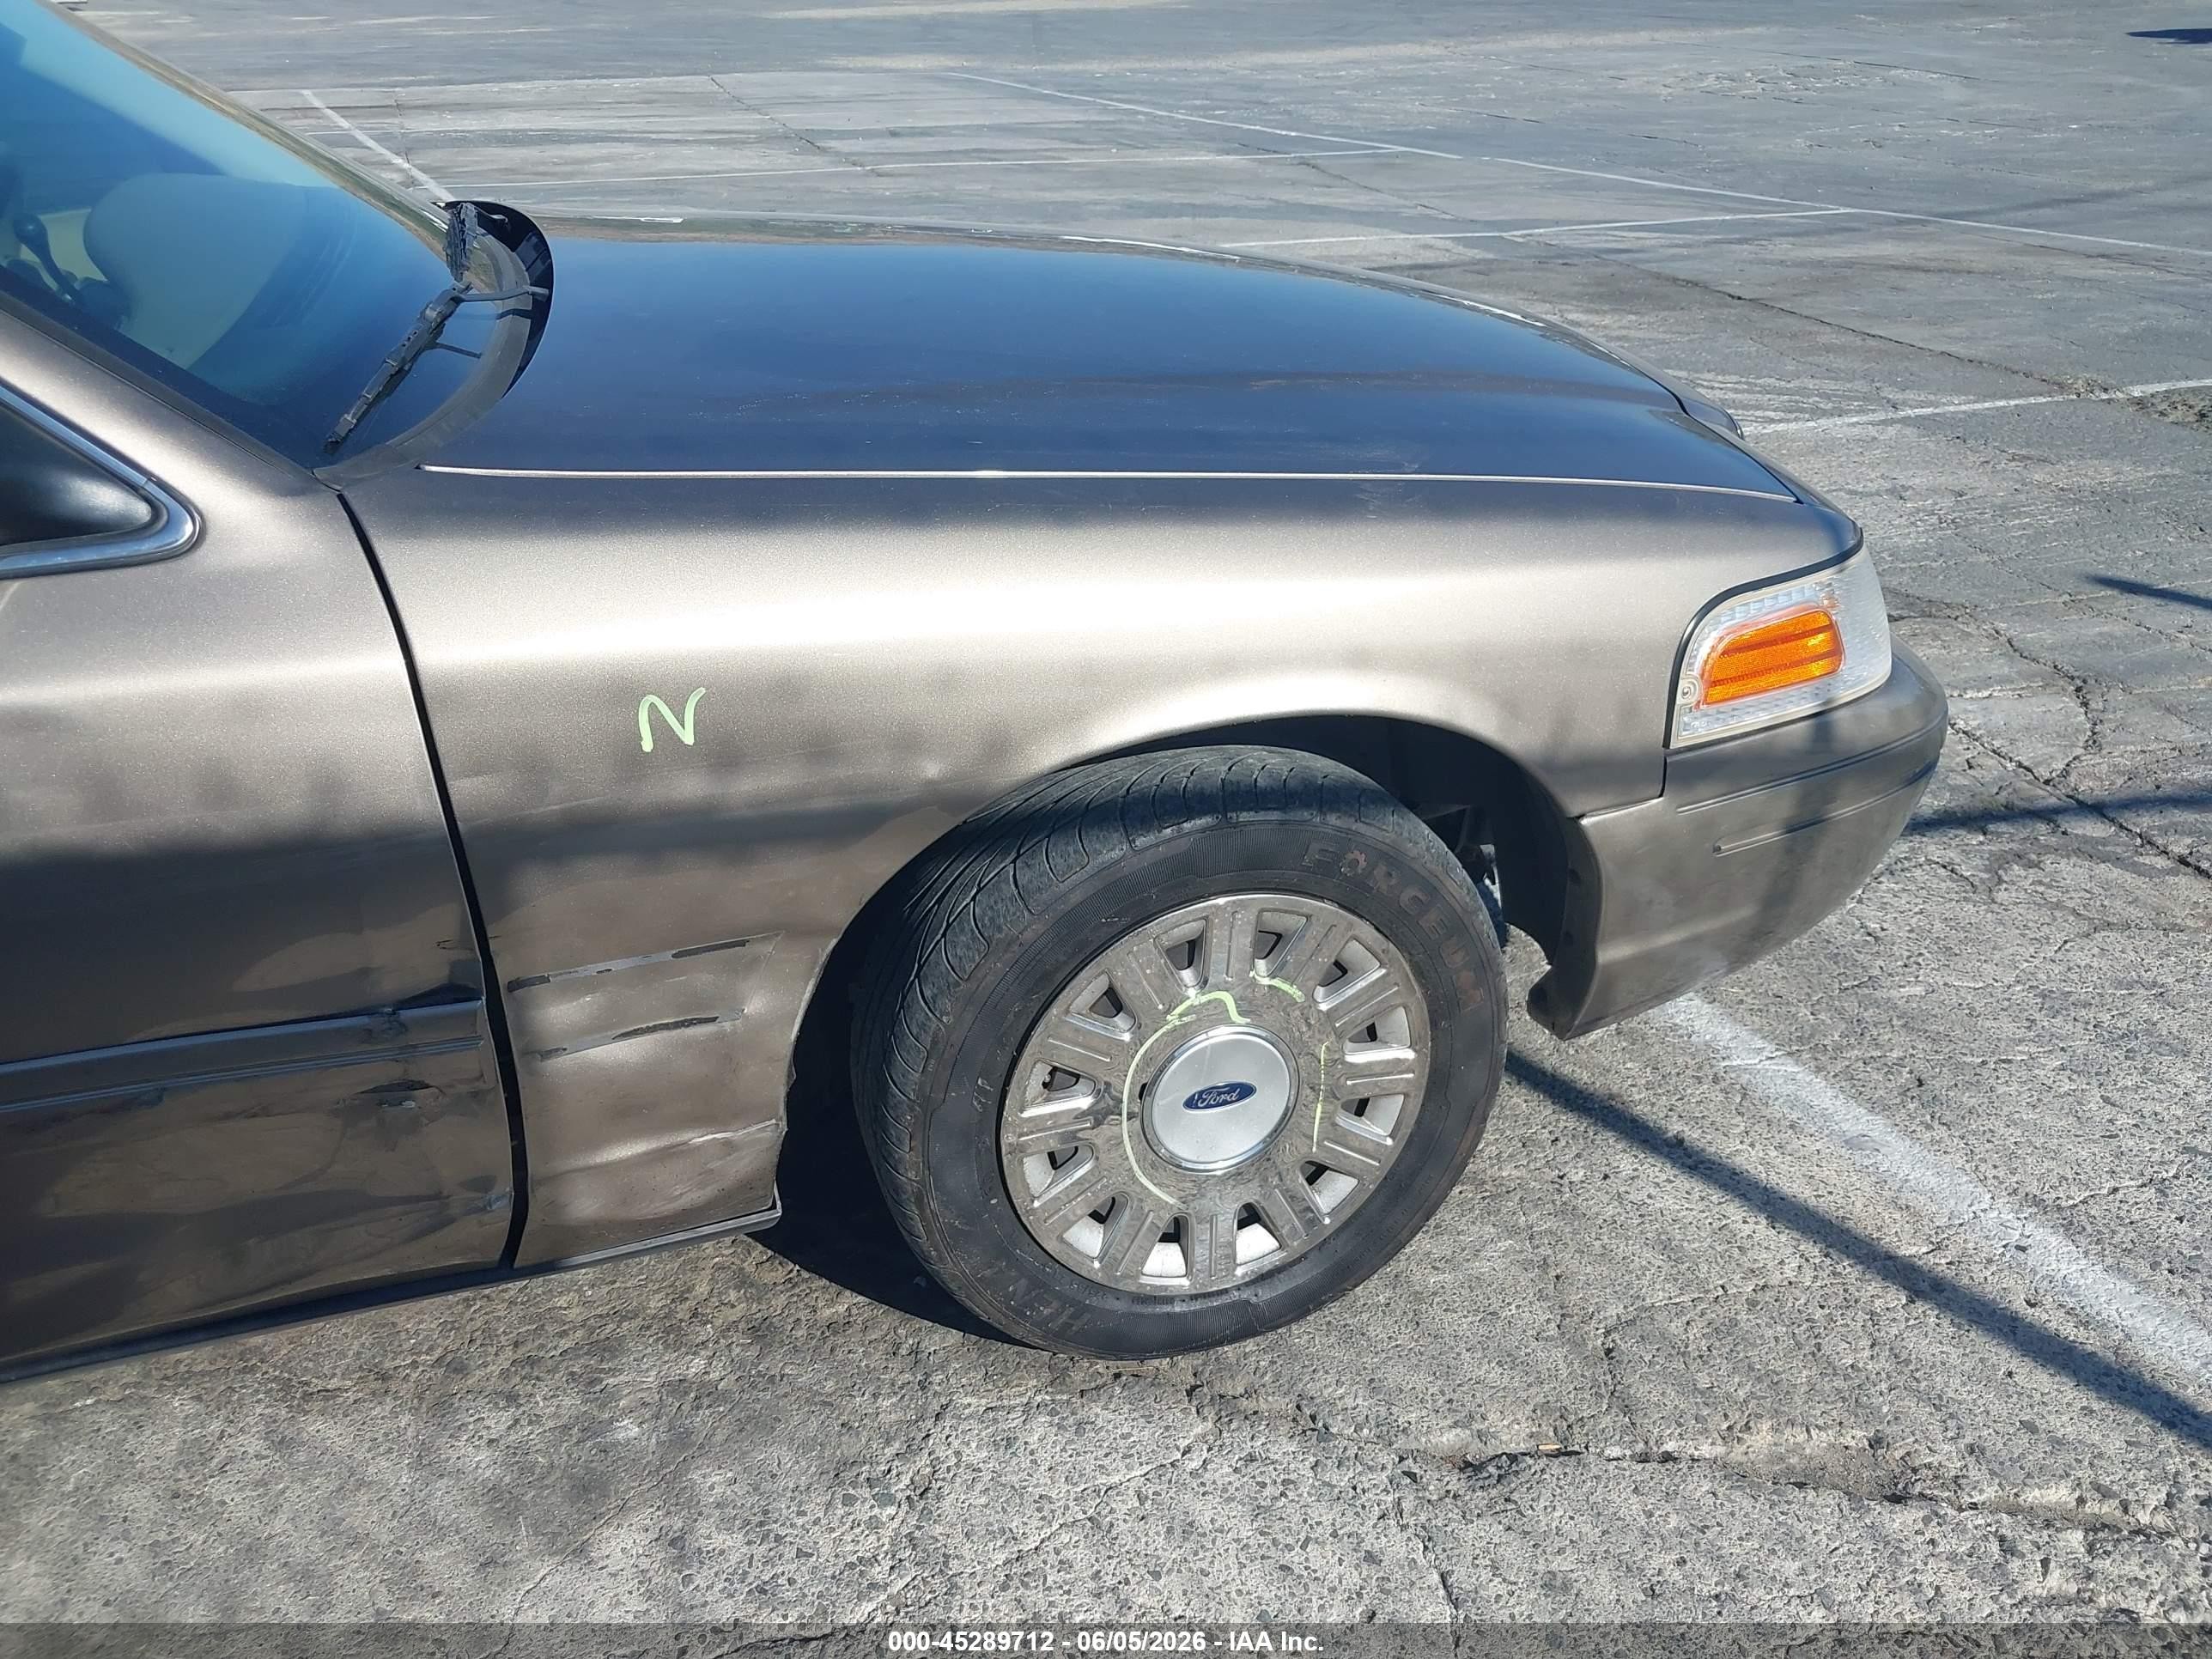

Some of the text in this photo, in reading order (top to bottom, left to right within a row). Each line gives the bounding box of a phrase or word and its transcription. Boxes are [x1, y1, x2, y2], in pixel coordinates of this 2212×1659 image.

[638, 686, 706, 753] N
[1301, 841, 1485, 1014] FORCEUM
[1198, 1087, 1240, 1107] Ford
